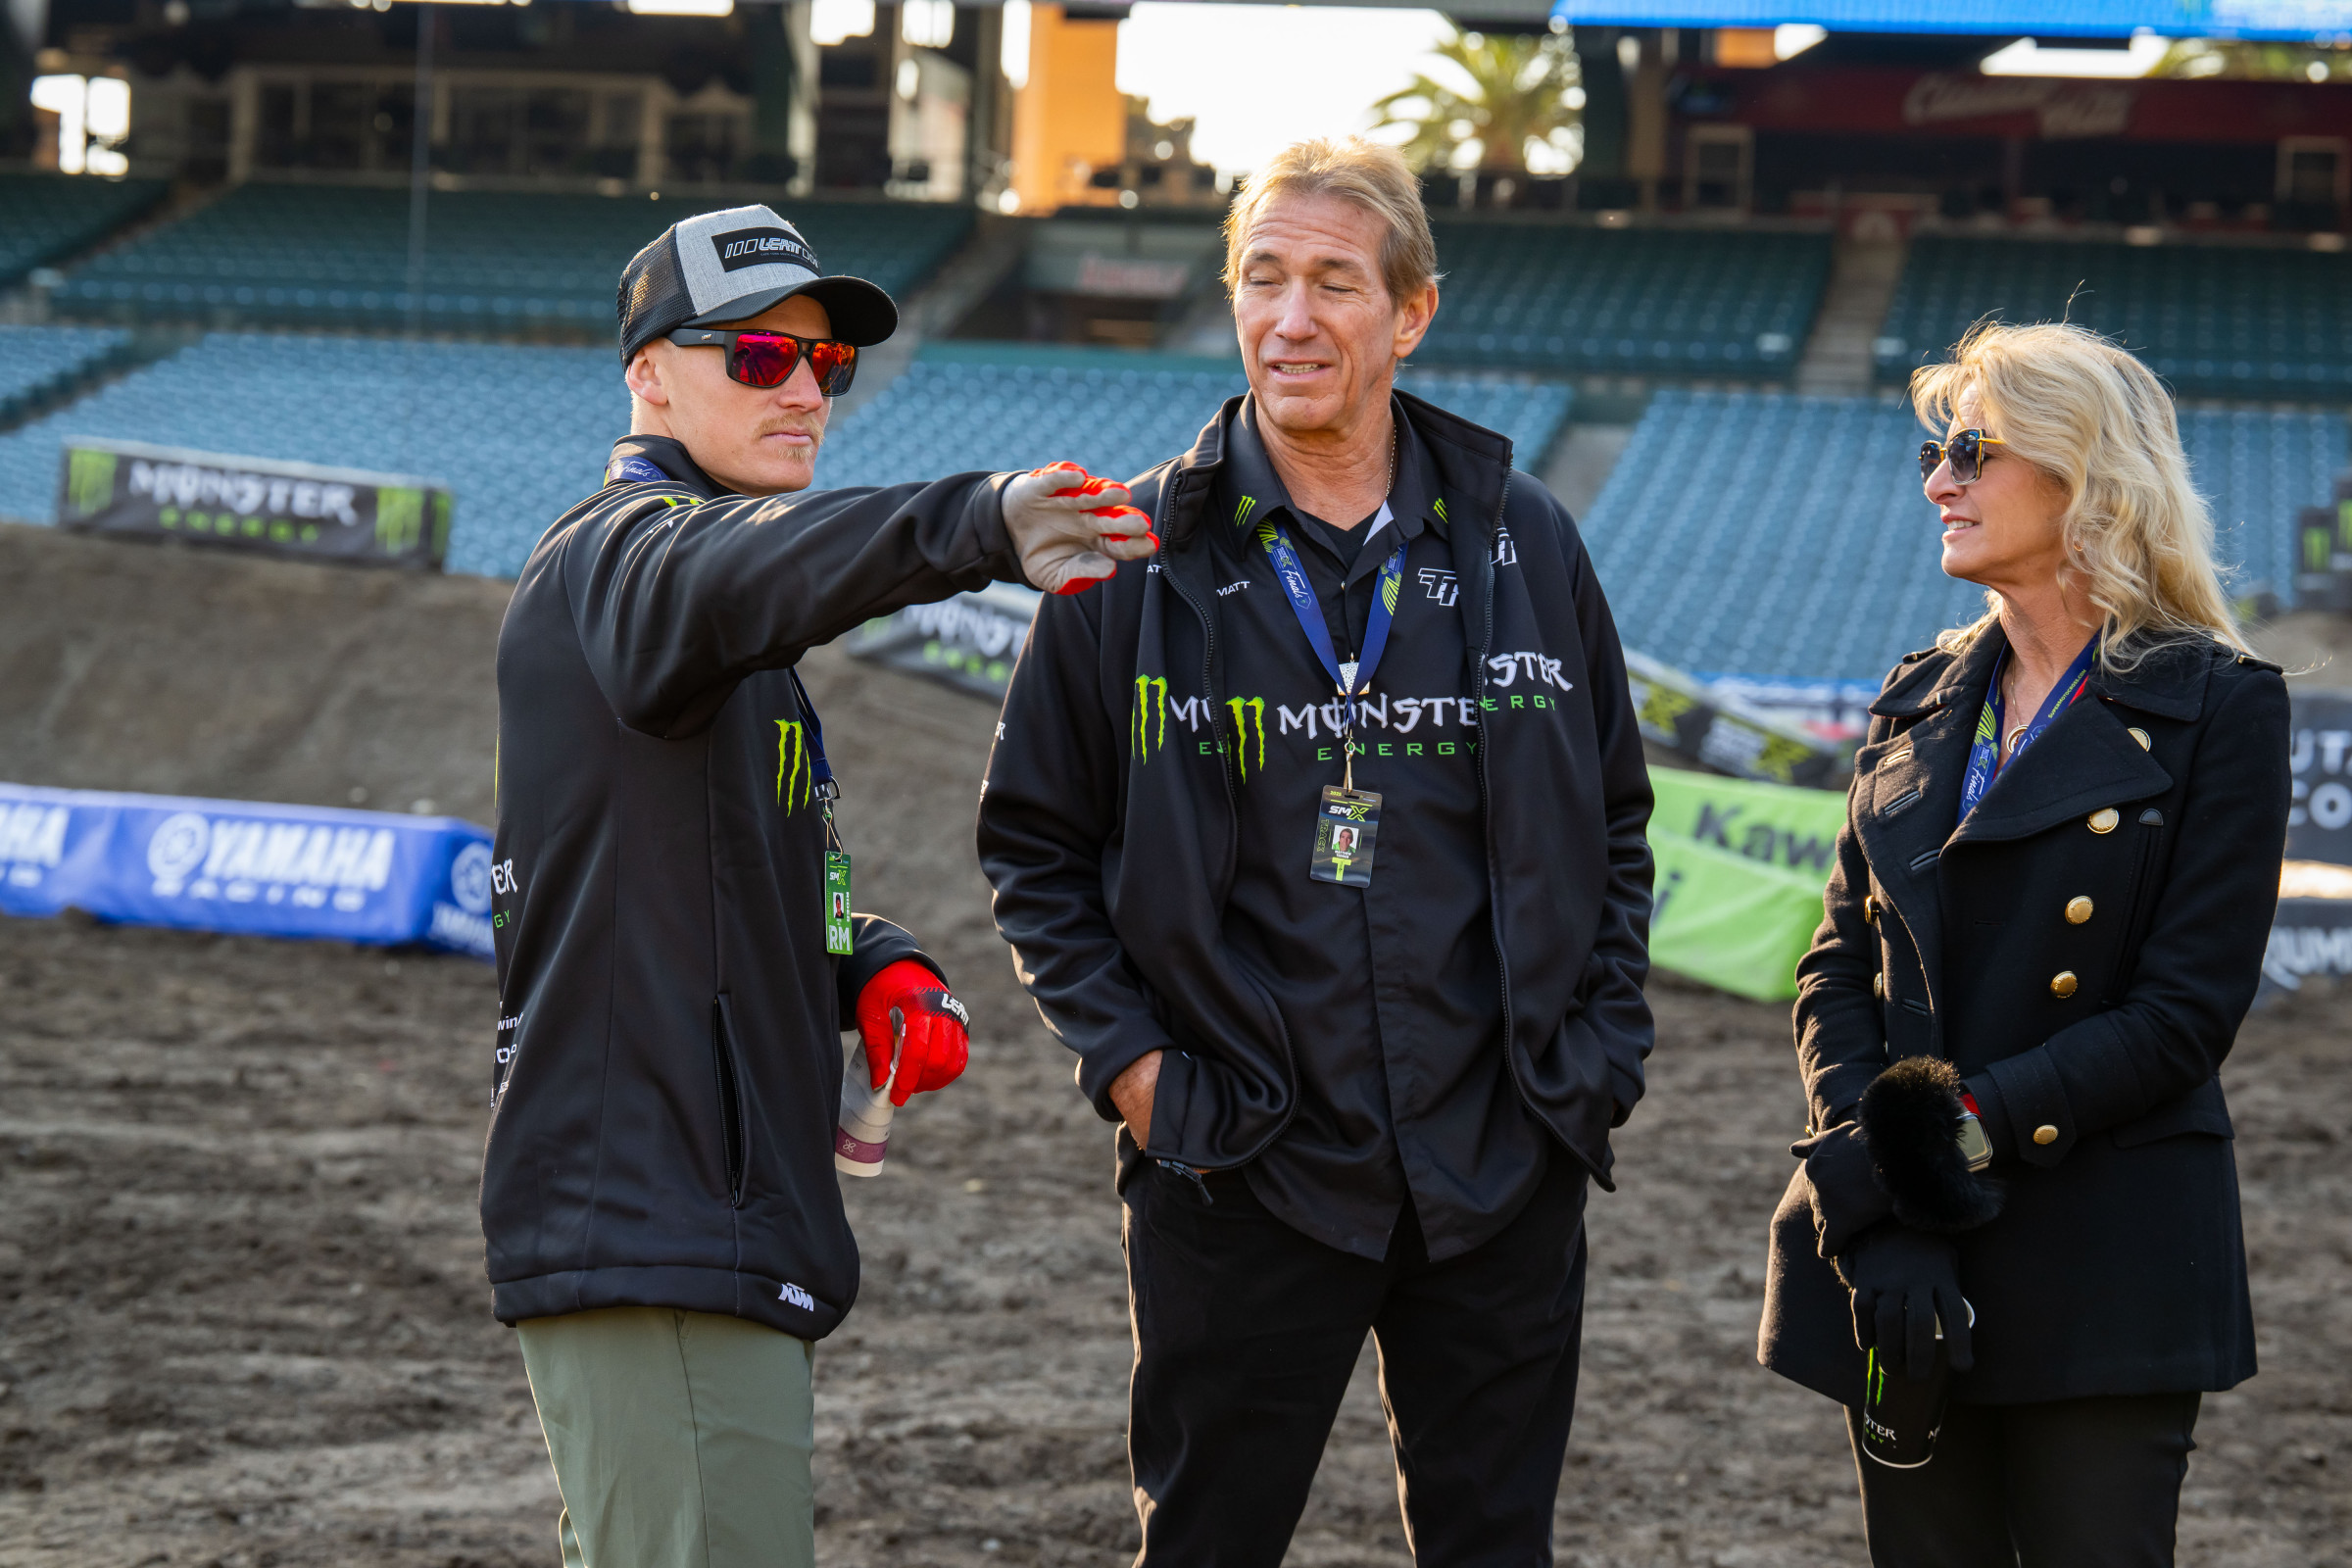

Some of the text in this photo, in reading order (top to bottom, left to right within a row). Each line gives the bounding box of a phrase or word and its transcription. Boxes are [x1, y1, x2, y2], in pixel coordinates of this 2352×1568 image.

[1282, 568, 1309, 599] Finals
[1481, 652, 1573, 692] STER
[1963, 767, 1985, 802] Finals
[1329, 806, 1369, 822] SMX
[1317, 819, 1330, 853] TRACK
[203, 819, 395, 892] YAMAHA
[829, 869, 847, 886] SMX
[828, 924, 851, 952] RM
[778, 1282, 814, 1312] KTM
